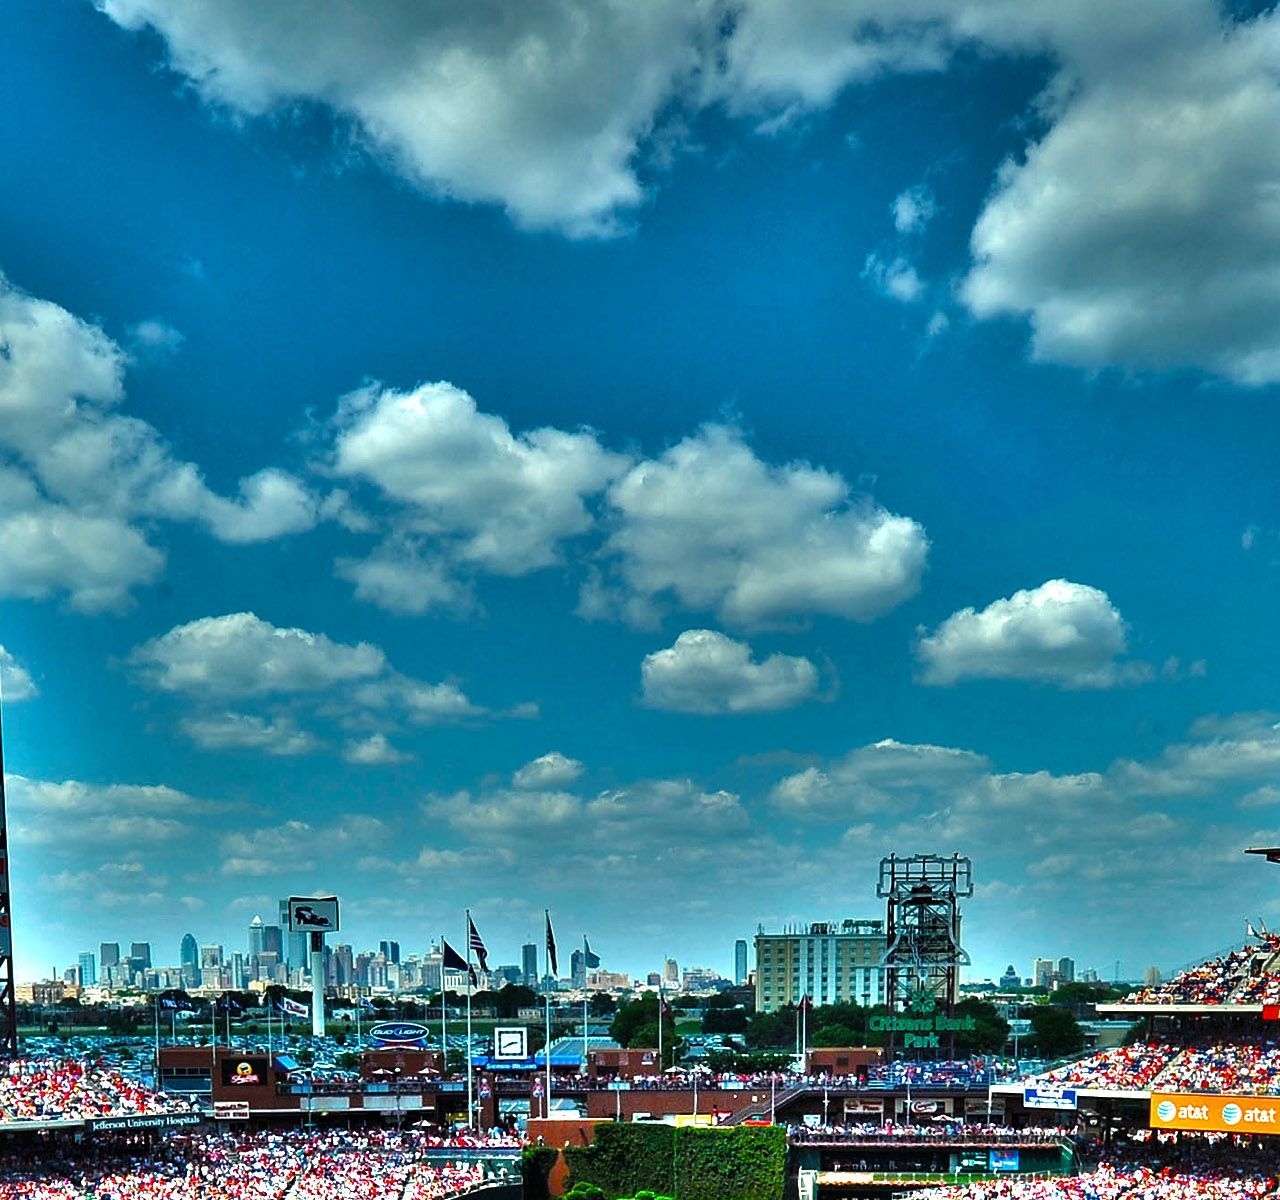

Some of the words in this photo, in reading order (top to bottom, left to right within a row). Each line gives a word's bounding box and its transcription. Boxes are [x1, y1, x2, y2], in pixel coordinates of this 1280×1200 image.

[869, 1015, 934, 1032] Citizens
[935, 1015, 976, 1032] Bank
[904, 1032, 940, 1049] Park
[1177, 1104, 1209, 1120] at&t
[1243, 1106, 1276, 1123] at&t
[92, 1119, 126, 1131] Jefferson
[127, 1117, 164, 1129] University
[166, 1115, 201, 1126] Hospitals
